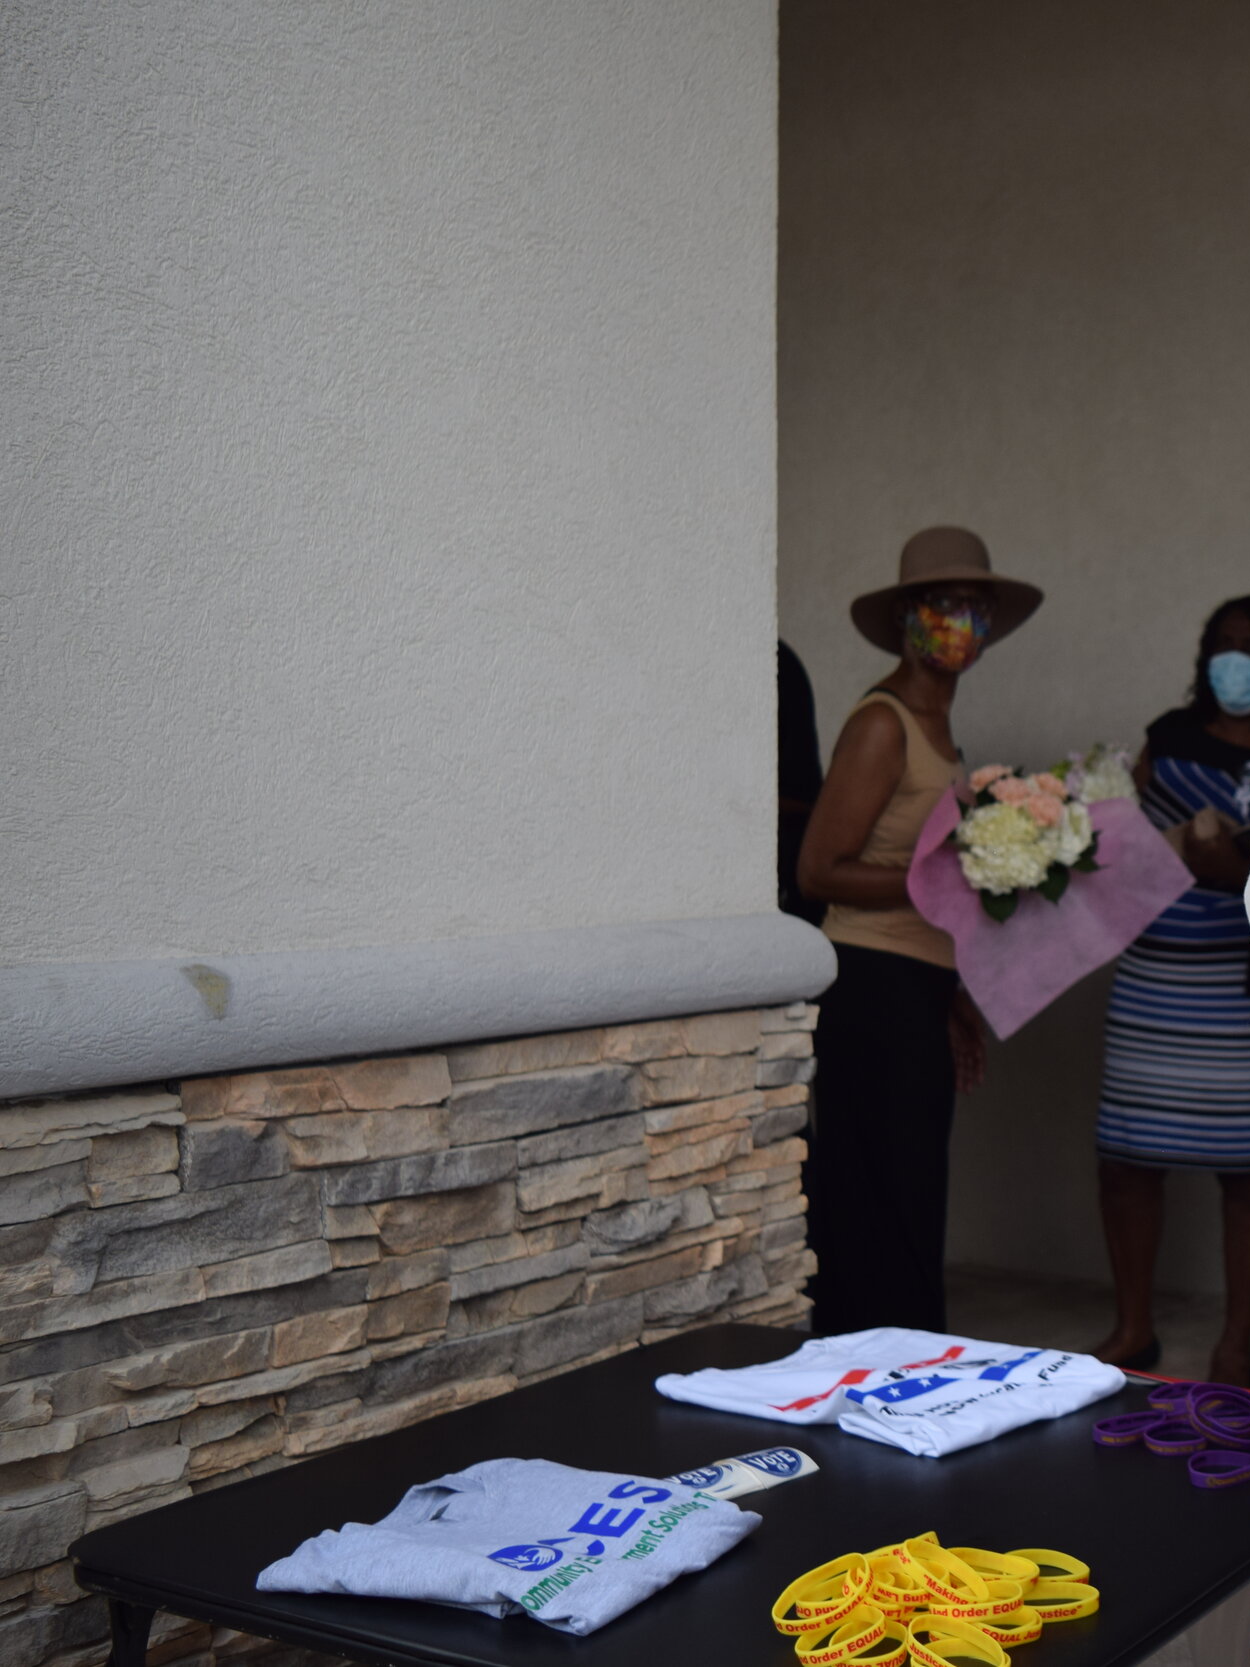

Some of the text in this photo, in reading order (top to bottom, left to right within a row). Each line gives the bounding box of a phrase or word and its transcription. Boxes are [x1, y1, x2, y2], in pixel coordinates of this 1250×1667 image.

[1037, 1355, 1073, 1381] Fund
[748, 1450, 797, 1470] VOTE
[665, 1467, 718, 1485] VOTE
[520, 1557, 593, 1611] ommunity
[951, 1607, 989, 1618] Order
[992, 1598, 1024, 1615] EQUA
[785, 1622, 821, 1633] Order
[810, 1649, 844, 1665] Order
[847, 1626, 884, 1653] EQUAL
